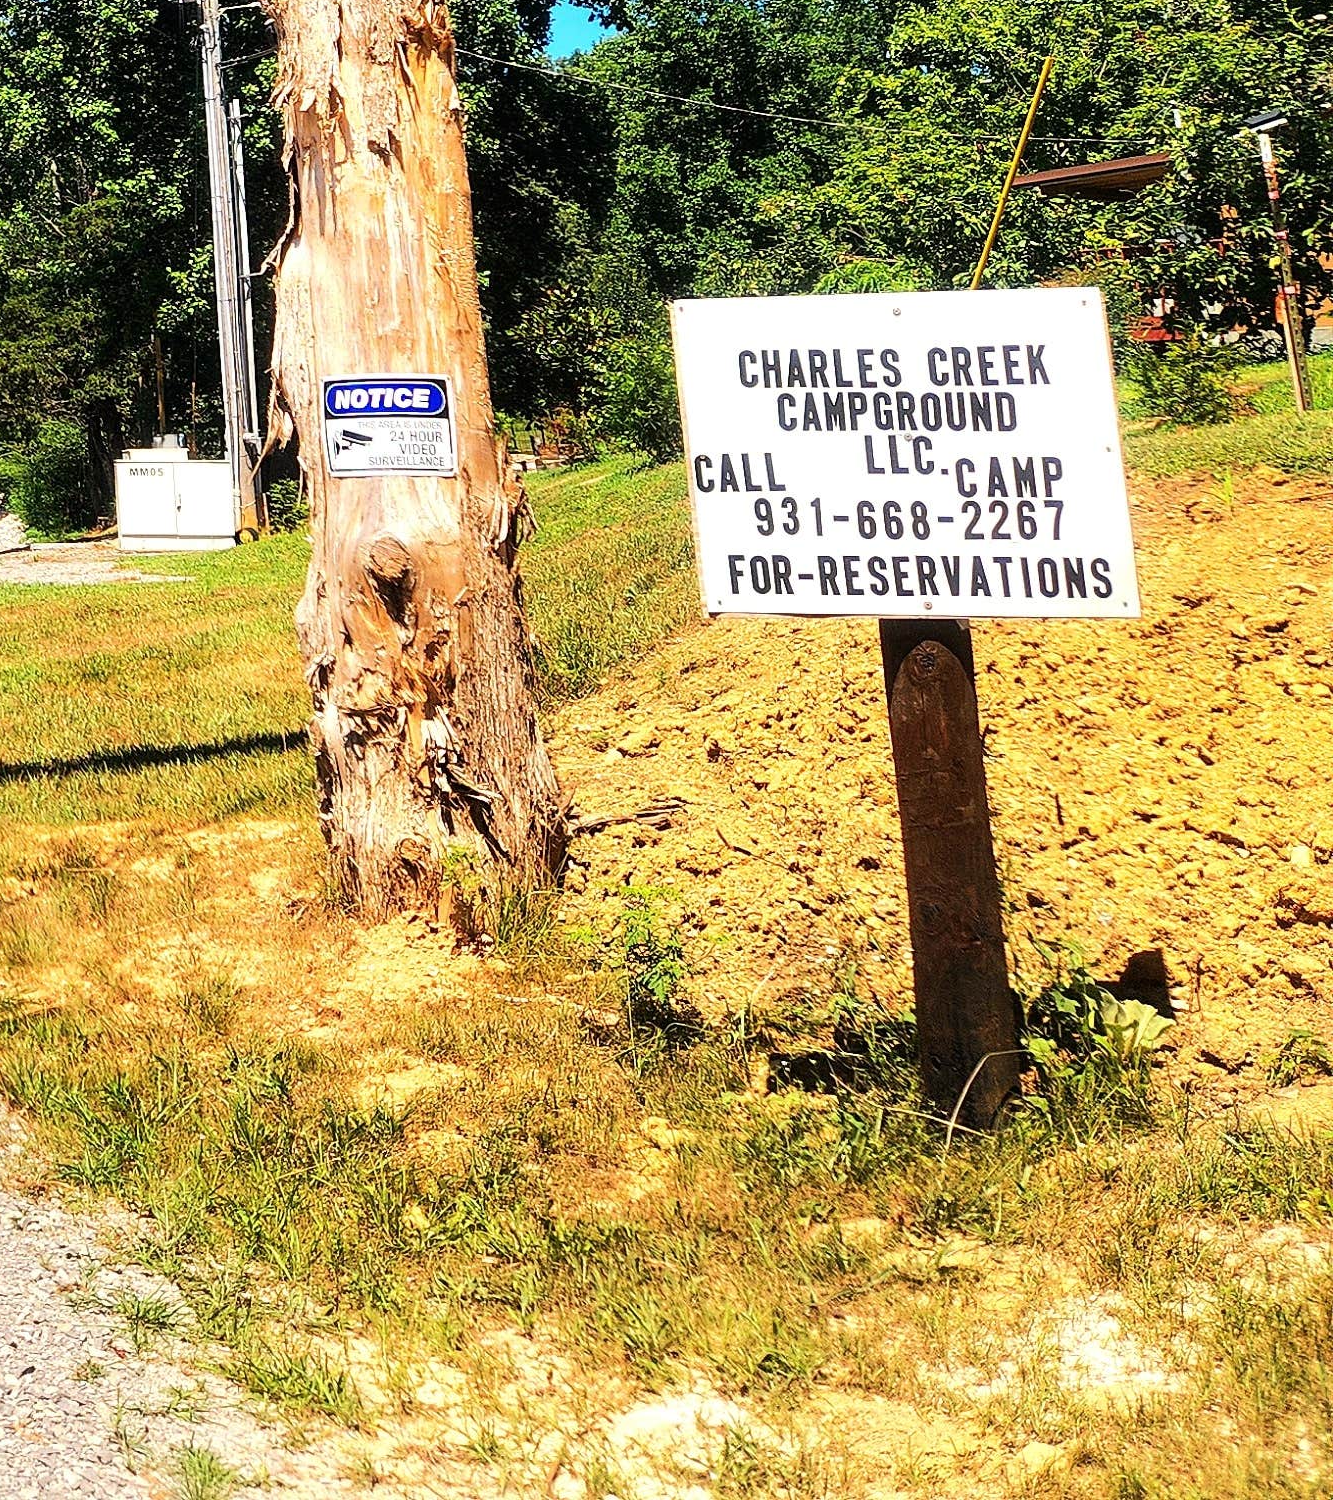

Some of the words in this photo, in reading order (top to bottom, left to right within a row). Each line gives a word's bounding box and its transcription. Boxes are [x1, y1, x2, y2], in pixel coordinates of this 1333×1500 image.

[739, 349, 902, 388] CHARLES
[928, 344, 1051, 387] CREEK
[334, 387, 431, 410] NOTICE
[777, 391, 1018, 432] CAMPGROUND
[389, 430, 405, 442] 24
[409, 430, 443, 443] HOUR
[399, 443, 437, 456] VIDEO
[864, 434, 949, 475] LLC.
[368, 456, 445, 467] SURVEILLANCE
[694, 452, 787, 493] CALL
[956, 456, 1063, 498] CAMP
[755, 497, 1065, 540] 931-668-2267
[728, 554, 1113, 598] FOR-RESERVATIONS
